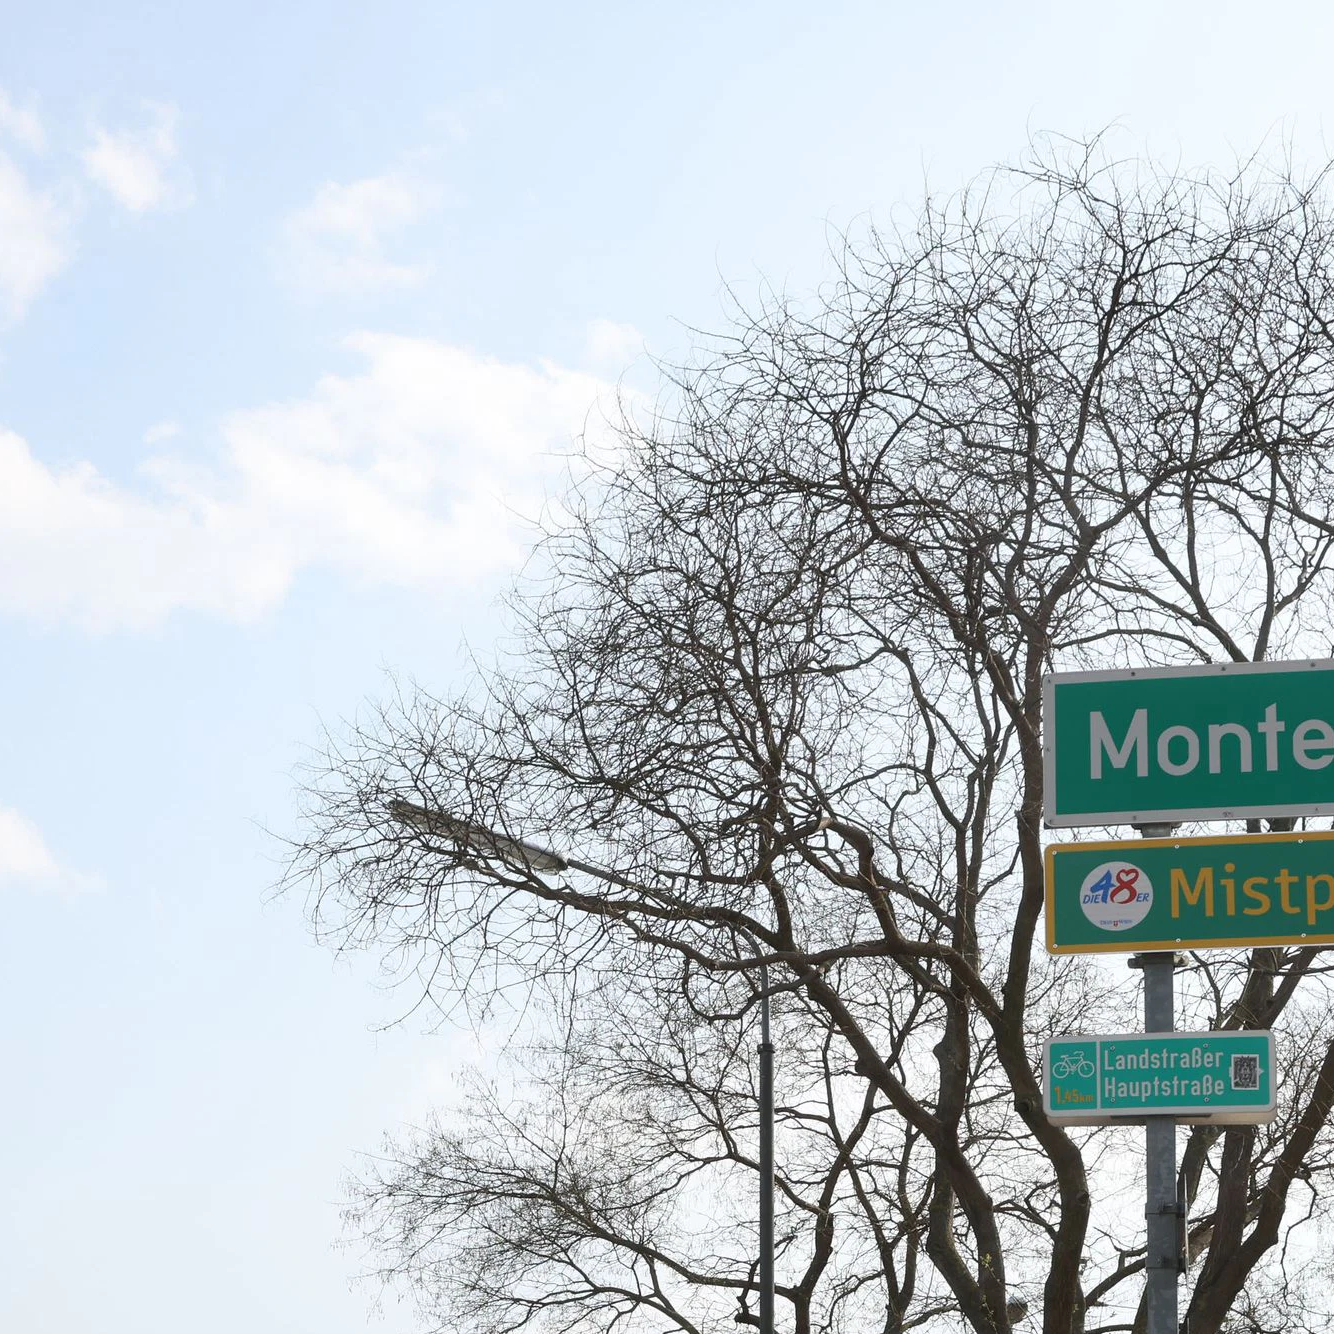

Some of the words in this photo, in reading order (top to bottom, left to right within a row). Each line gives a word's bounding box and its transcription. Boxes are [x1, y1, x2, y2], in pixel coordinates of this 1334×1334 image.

[1082, 894, 1101, 905] DIE
[1136, 892, 1150, 903] ER
[1104, 1047, 1224, 1070] Landstraßer
[1104, 1075, 1225, 1101] Hauptstraße
